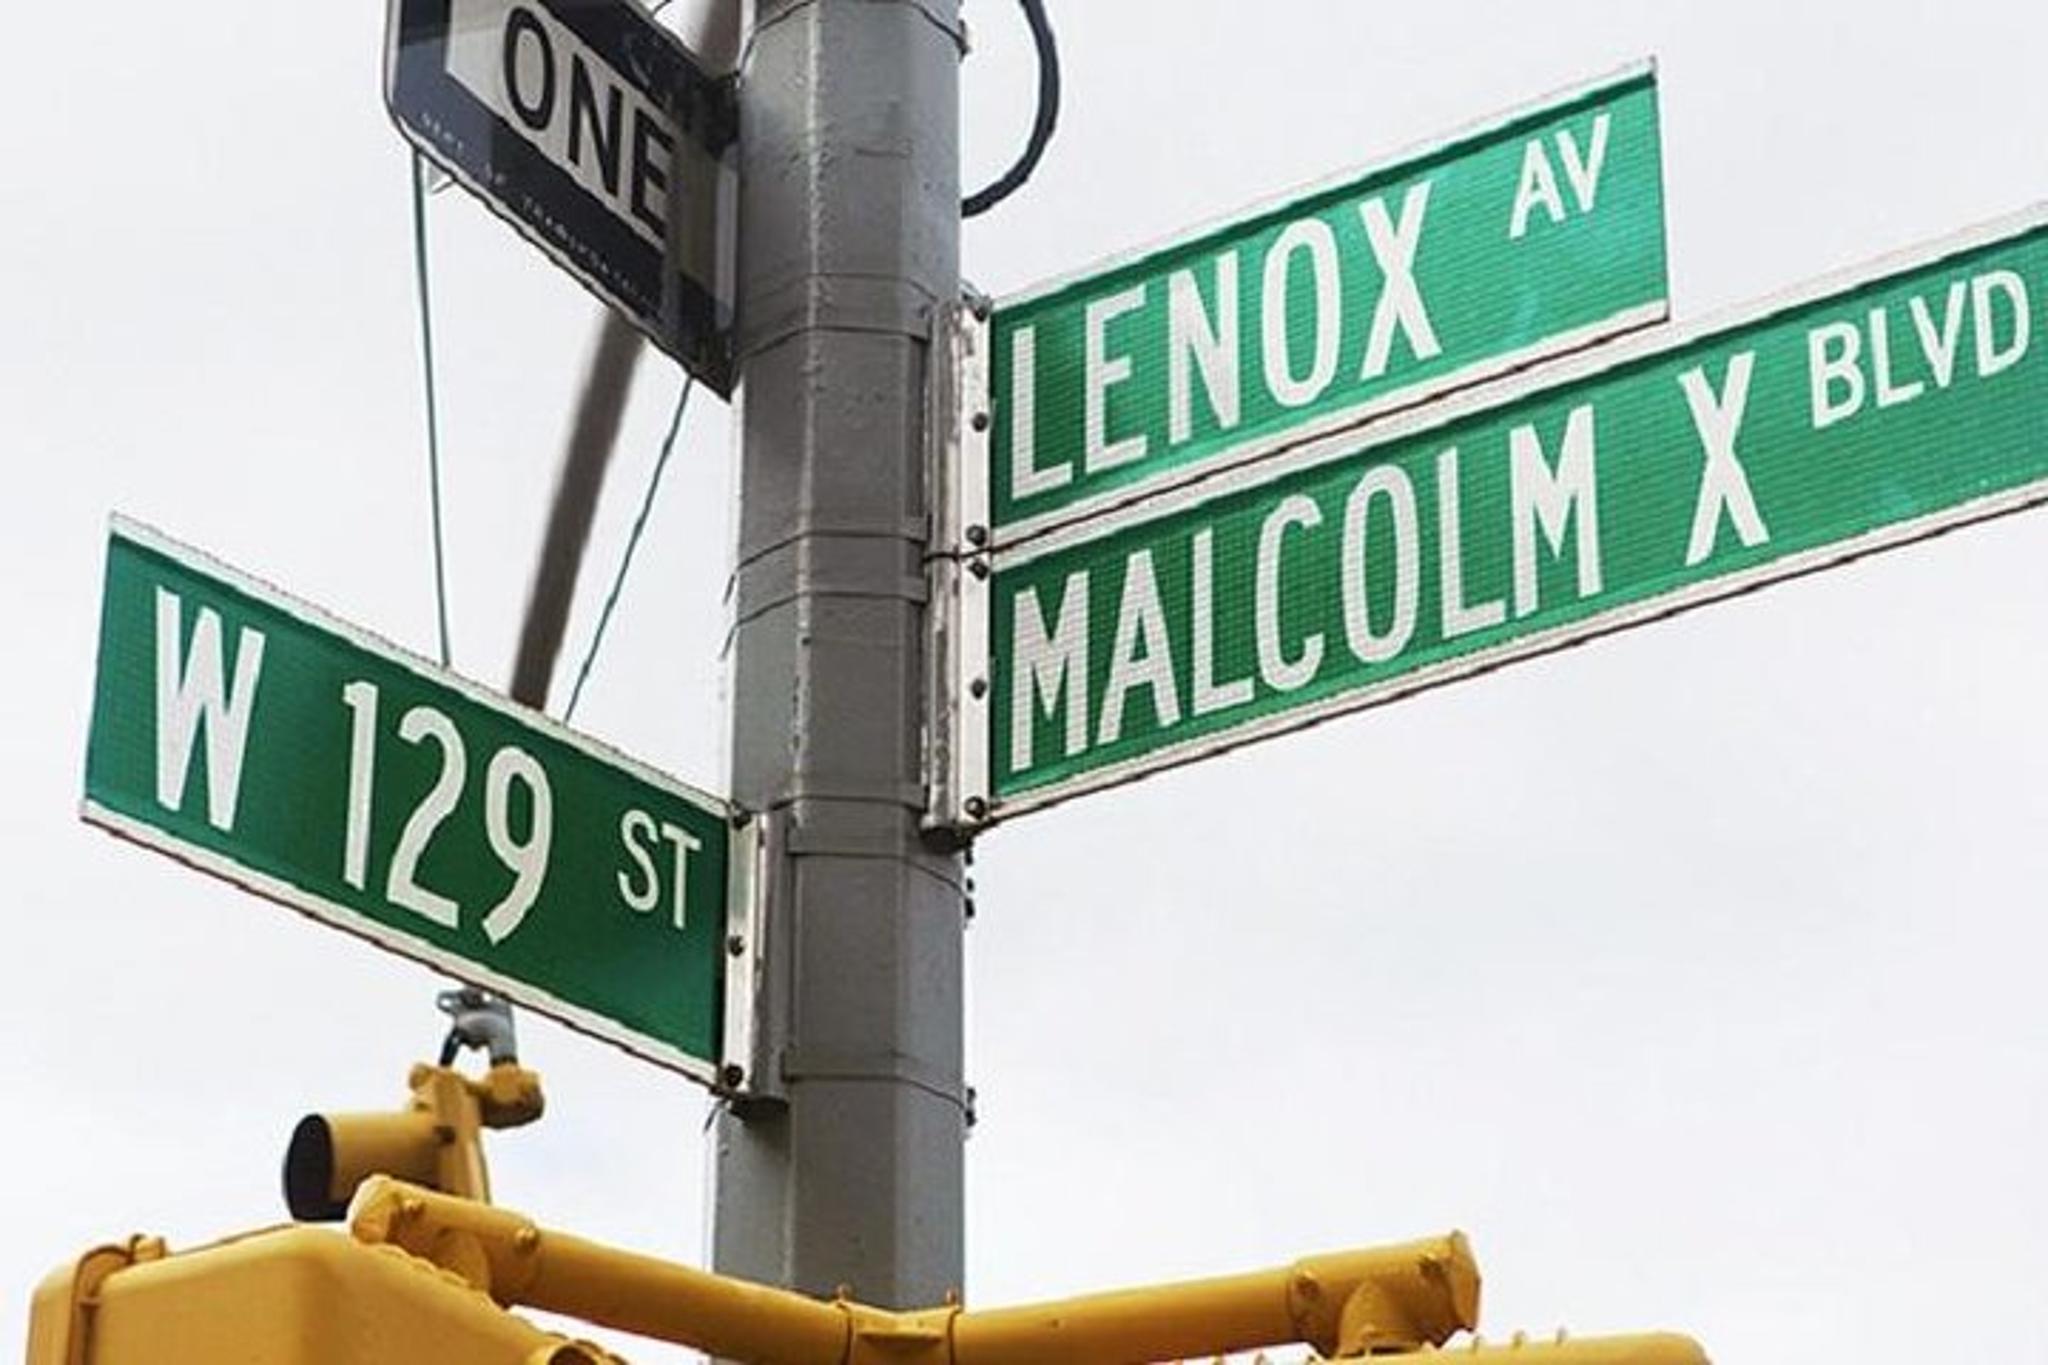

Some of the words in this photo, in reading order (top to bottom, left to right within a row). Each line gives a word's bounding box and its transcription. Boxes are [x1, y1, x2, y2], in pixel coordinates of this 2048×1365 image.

[503, 6, 674, 242] ONE
[1012, 178, 1442, 499] LENOX
[1509, 112, 1611, 240] AV
[1011, 403, 1603, 772] MALCOLM
[1677, 350, 1770, 567] X
[1807, 269, 2030, 429] BLVD
[155, 585, 266, 831] W
[343, 681, 553, 945] 129
[617, 808, 701, 929] ST
